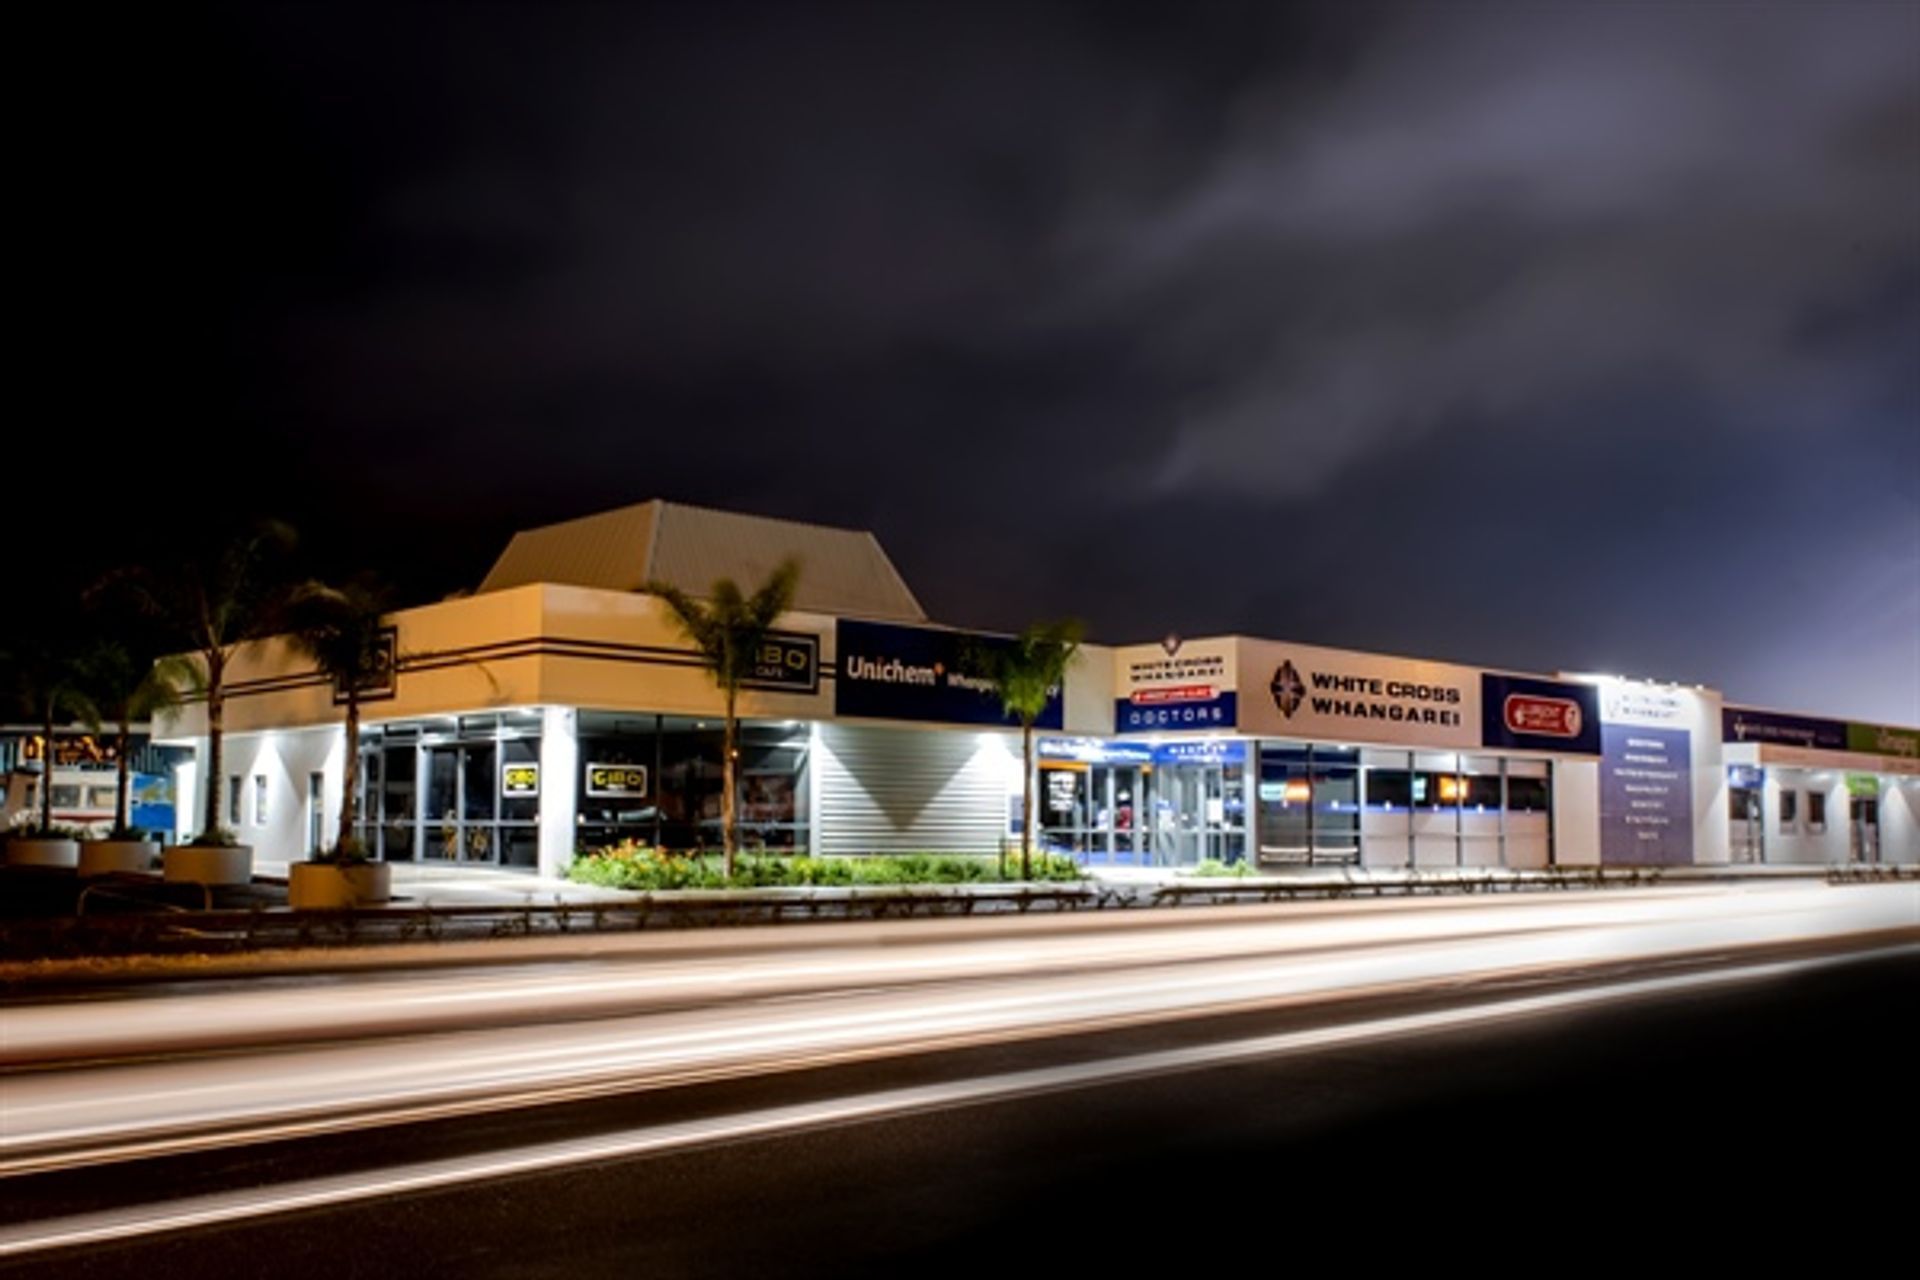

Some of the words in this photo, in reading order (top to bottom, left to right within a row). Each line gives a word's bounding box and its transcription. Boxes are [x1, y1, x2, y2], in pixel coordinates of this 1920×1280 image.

[847, 656, 936, 686] Unichem
[1311, 671, 1383, 696] WHITE
[1385, 681, 1461, 705] CROSS
[1129, 707, 1223, 725] DOCTORS
[1311, 697, 1461, 727] WHANGAREI
[593, 770, 642, 786] GIBO
